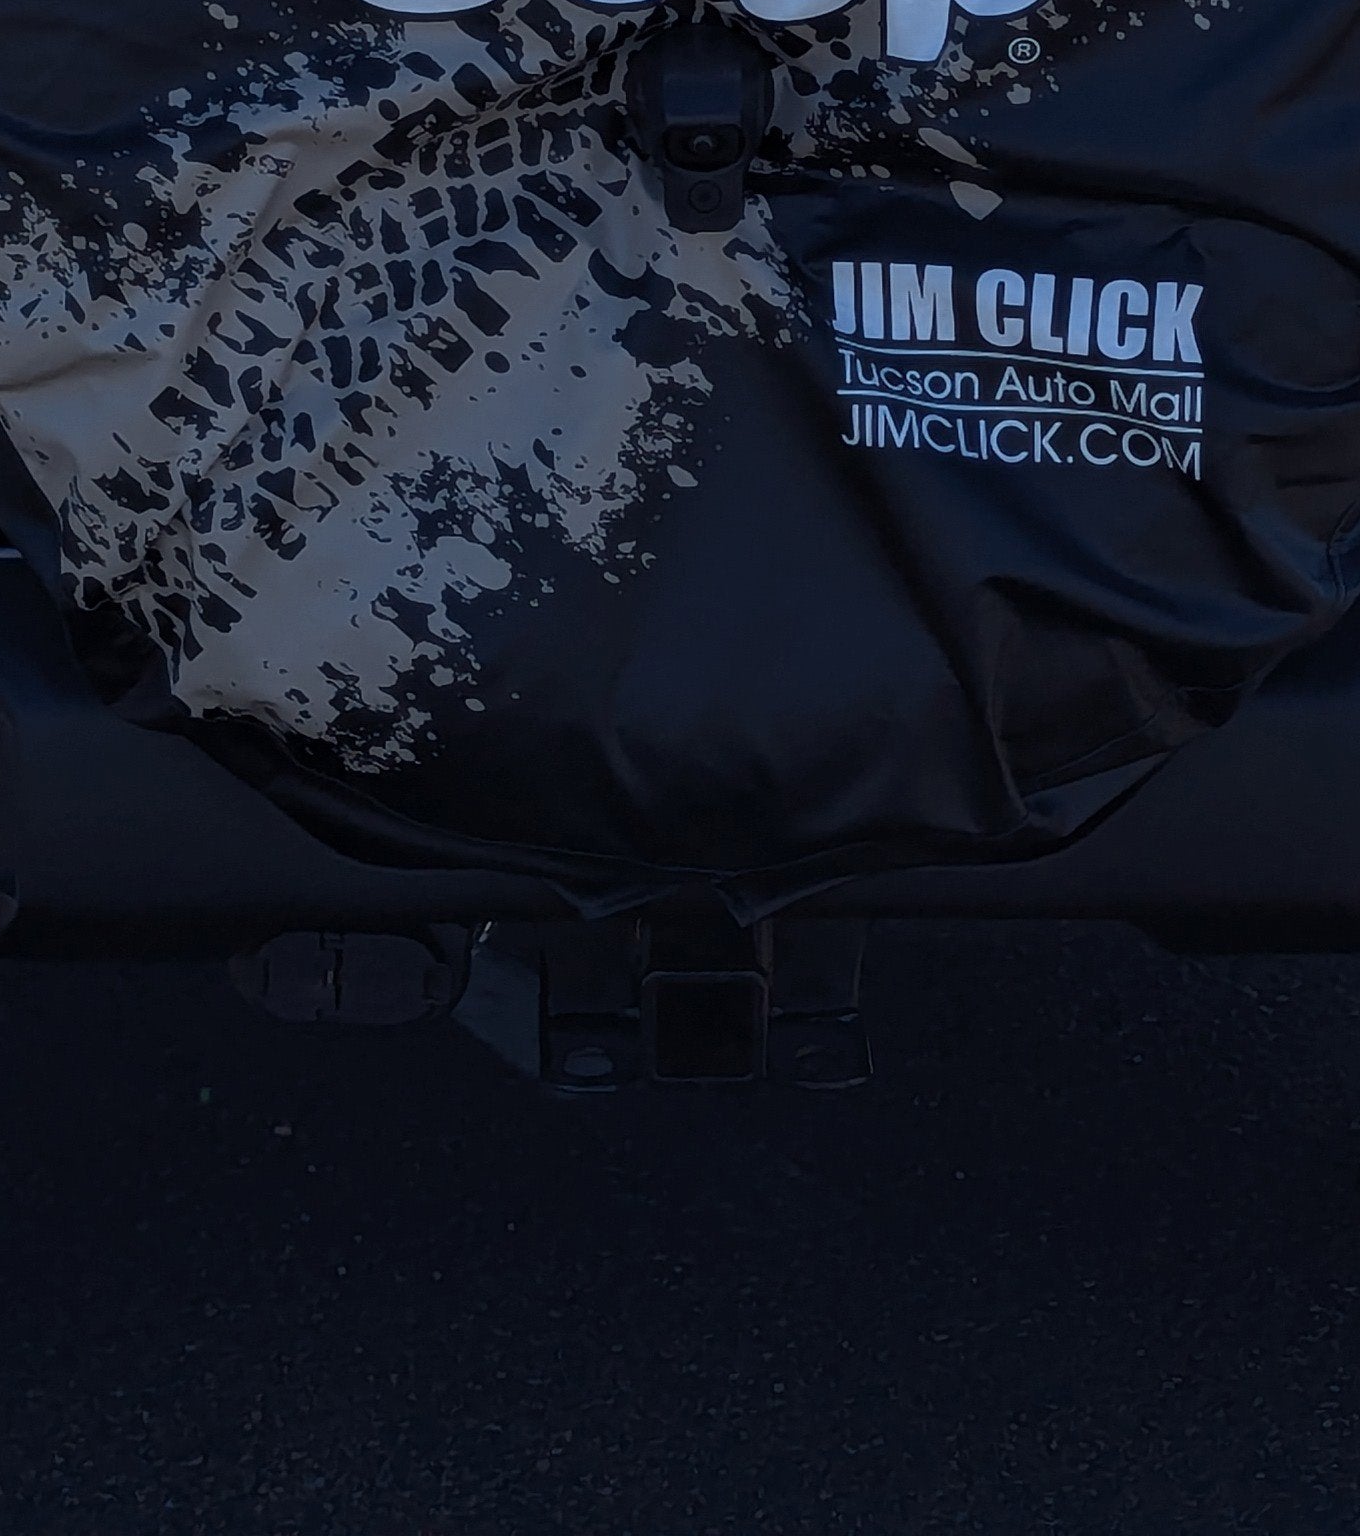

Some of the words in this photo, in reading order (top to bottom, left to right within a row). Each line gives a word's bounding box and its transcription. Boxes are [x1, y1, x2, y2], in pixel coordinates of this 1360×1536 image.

[832, 261, 955, 341] JIM
[976, 269, 1204, 364] CLICK
[838, 348, 980, 400] Tucson
[995, 366, 1095, 406] Auto
[1110, 379, 1202, 422] Mall
[841, 404, 1202, 481] JIMCLICK.COM
